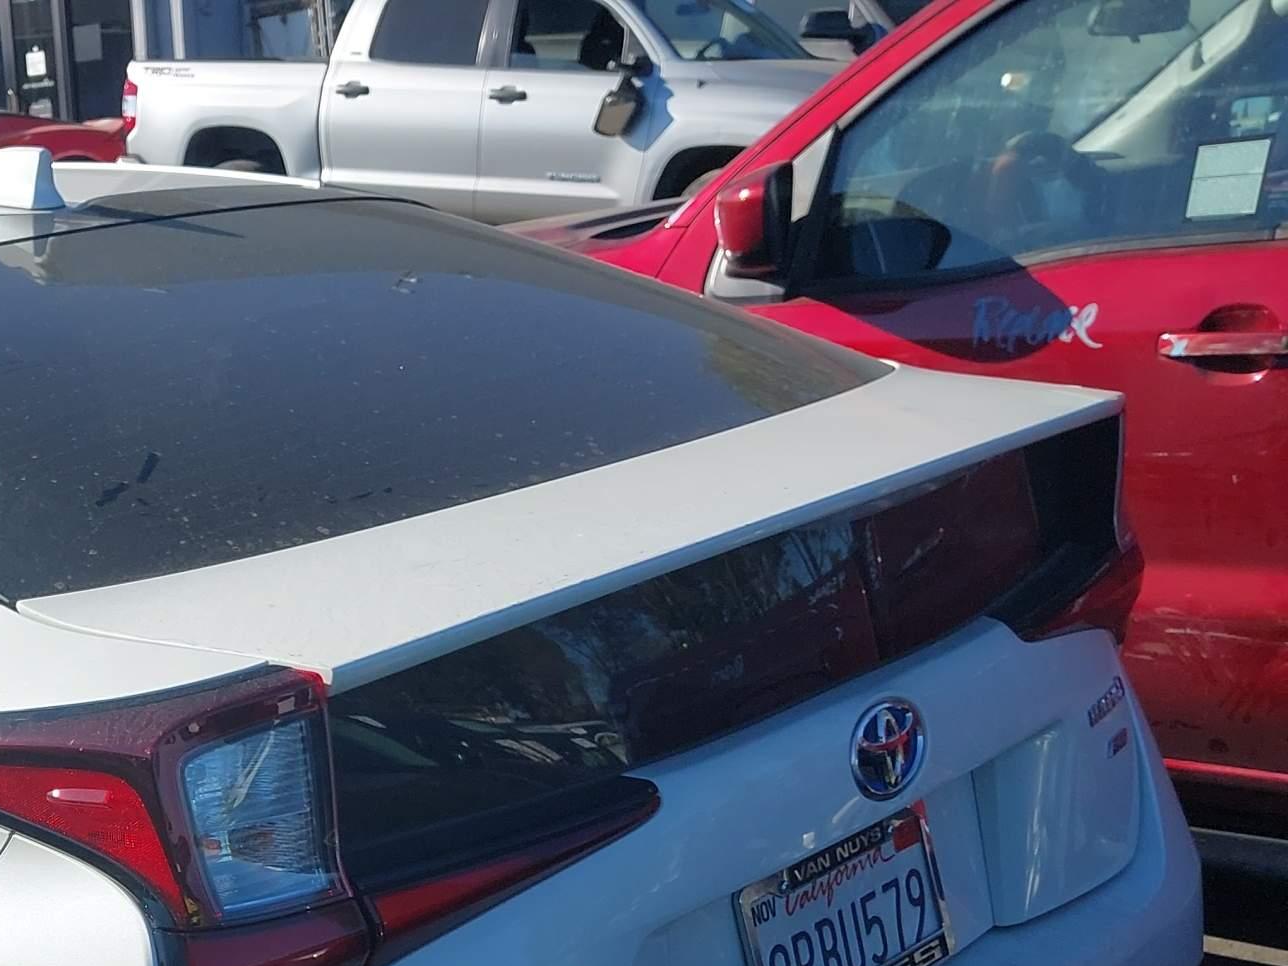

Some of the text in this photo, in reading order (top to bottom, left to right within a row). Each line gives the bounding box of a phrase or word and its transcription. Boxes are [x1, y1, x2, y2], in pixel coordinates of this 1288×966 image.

[784, 845, 895, 916] California
[793, 827, 882, 883] VAN NUYS
[751, 898, 777, 928] NOV
